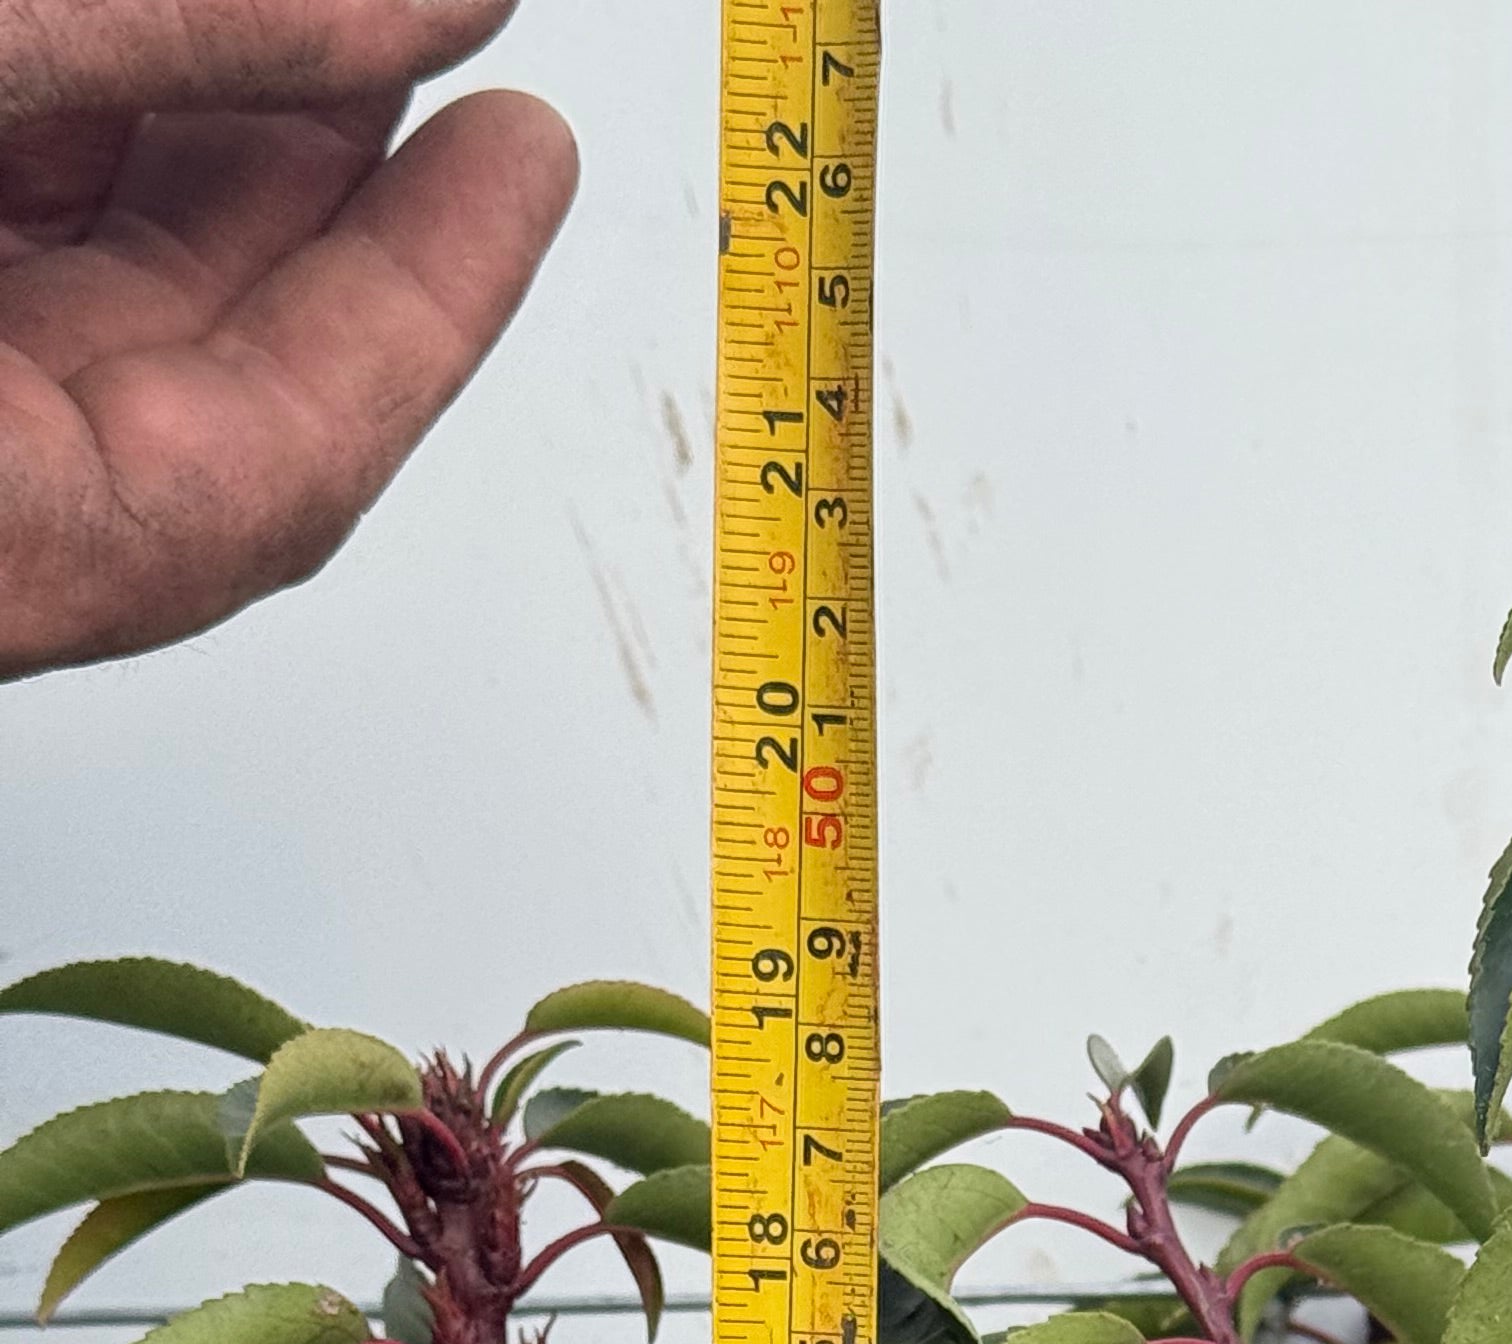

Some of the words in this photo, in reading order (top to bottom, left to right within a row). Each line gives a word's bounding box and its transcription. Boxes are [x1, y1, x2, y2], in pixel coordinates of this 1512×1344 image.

[822, 50, 854, 87] 7
[765, 121, 808, 217] 22
[819, 163, 852, 198] 6
[818, 275, 849, 309] 5
[815, 384, 847, 422] 4
[761, 410, 804, 498] 21
[814, 497, 848, 529] 3
[812, 604, 847, 640] 2
[755, 681, 799, 773] 20
[811, 713, 847, 736] 1
[803, 766, 843, 849] 50
[806, 926, 846, 960] 9
[751, 948, 794, 1030] 19
[804, 1033, 845, 1064] 8
[803, 1134, 842, 1166] 7
[748, 1213, 788, 1292] 18
[800, 1238, 841, 1269] 6
